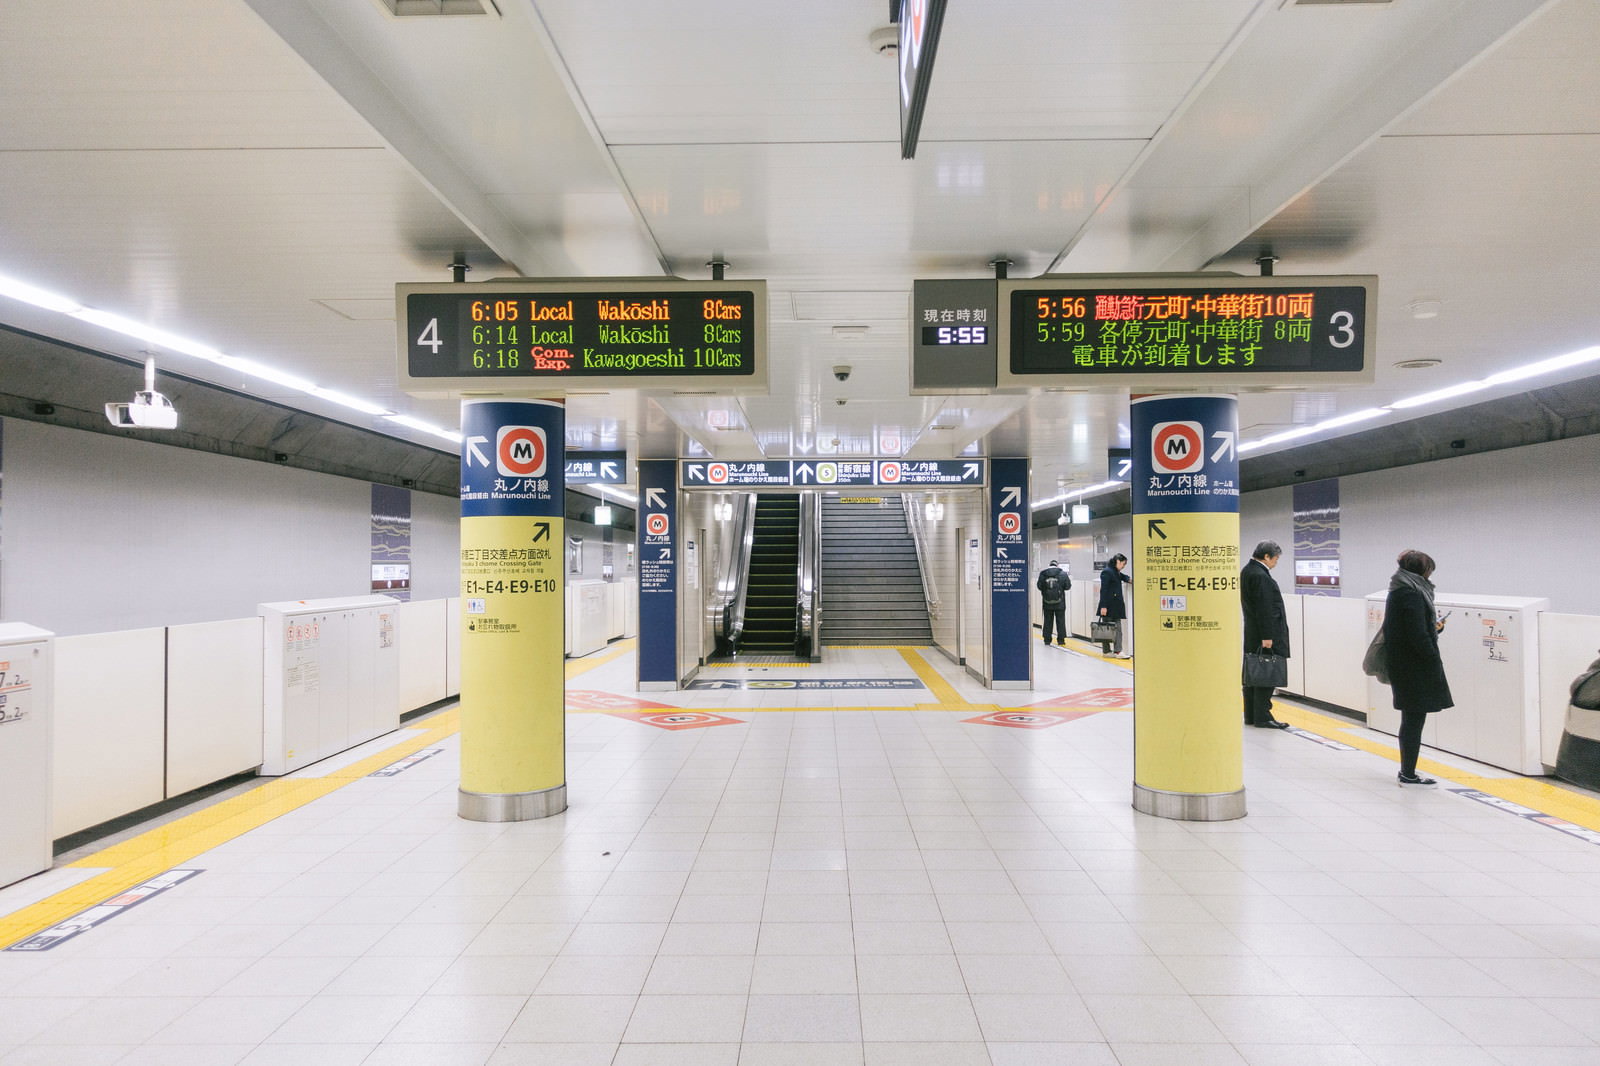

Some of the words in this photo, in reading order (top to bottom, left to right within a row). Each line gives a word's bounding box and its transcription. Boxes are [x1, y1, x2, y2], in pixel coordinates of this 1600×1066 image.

[472, 302, 518, 321] 6:05
[530, 301, 573, 321] Local
[598, 300, 670, 320] Wakōshi
[924, 309, 986, 322] 現在時刻
[1037, 298, 1086, 320] 5:56
[417, 318, 443, 354] 4
[472, 326, 518, 344] 6:14
[531, 325, 574, 344] Local
[599, 324, 670, 344] Wakōshi
[938, 327, 985, 344] 5:55
[1038, 322, 1084, 342] 5:59
[1275, 318, 1312, 342] 8両
[1328, 311, 1355, 348] 3
[474, 350, 518, 368] 6:18
[531, 347, 574, 358] Com.
[584, 348, 685, 369] Kawagoeshi
[534, 358, 570, 370] Exp.
[1072, 344, 1262, 368] 電車が到着します
[514, 443, 532, 458] M
[1167, 438, 1186, 454] M
[565, 462, 592, 472] ノ内線
[729, 463, 765, 472] 丸ノ内線
[902, 463, 938, 471] 丸ノ内線
[494, 478, 549, 492] 丸ノ内線
[1149, 474, 1208, 488] 丸ノ内線
[1148, 488, 1192, 496] Marunouchi
